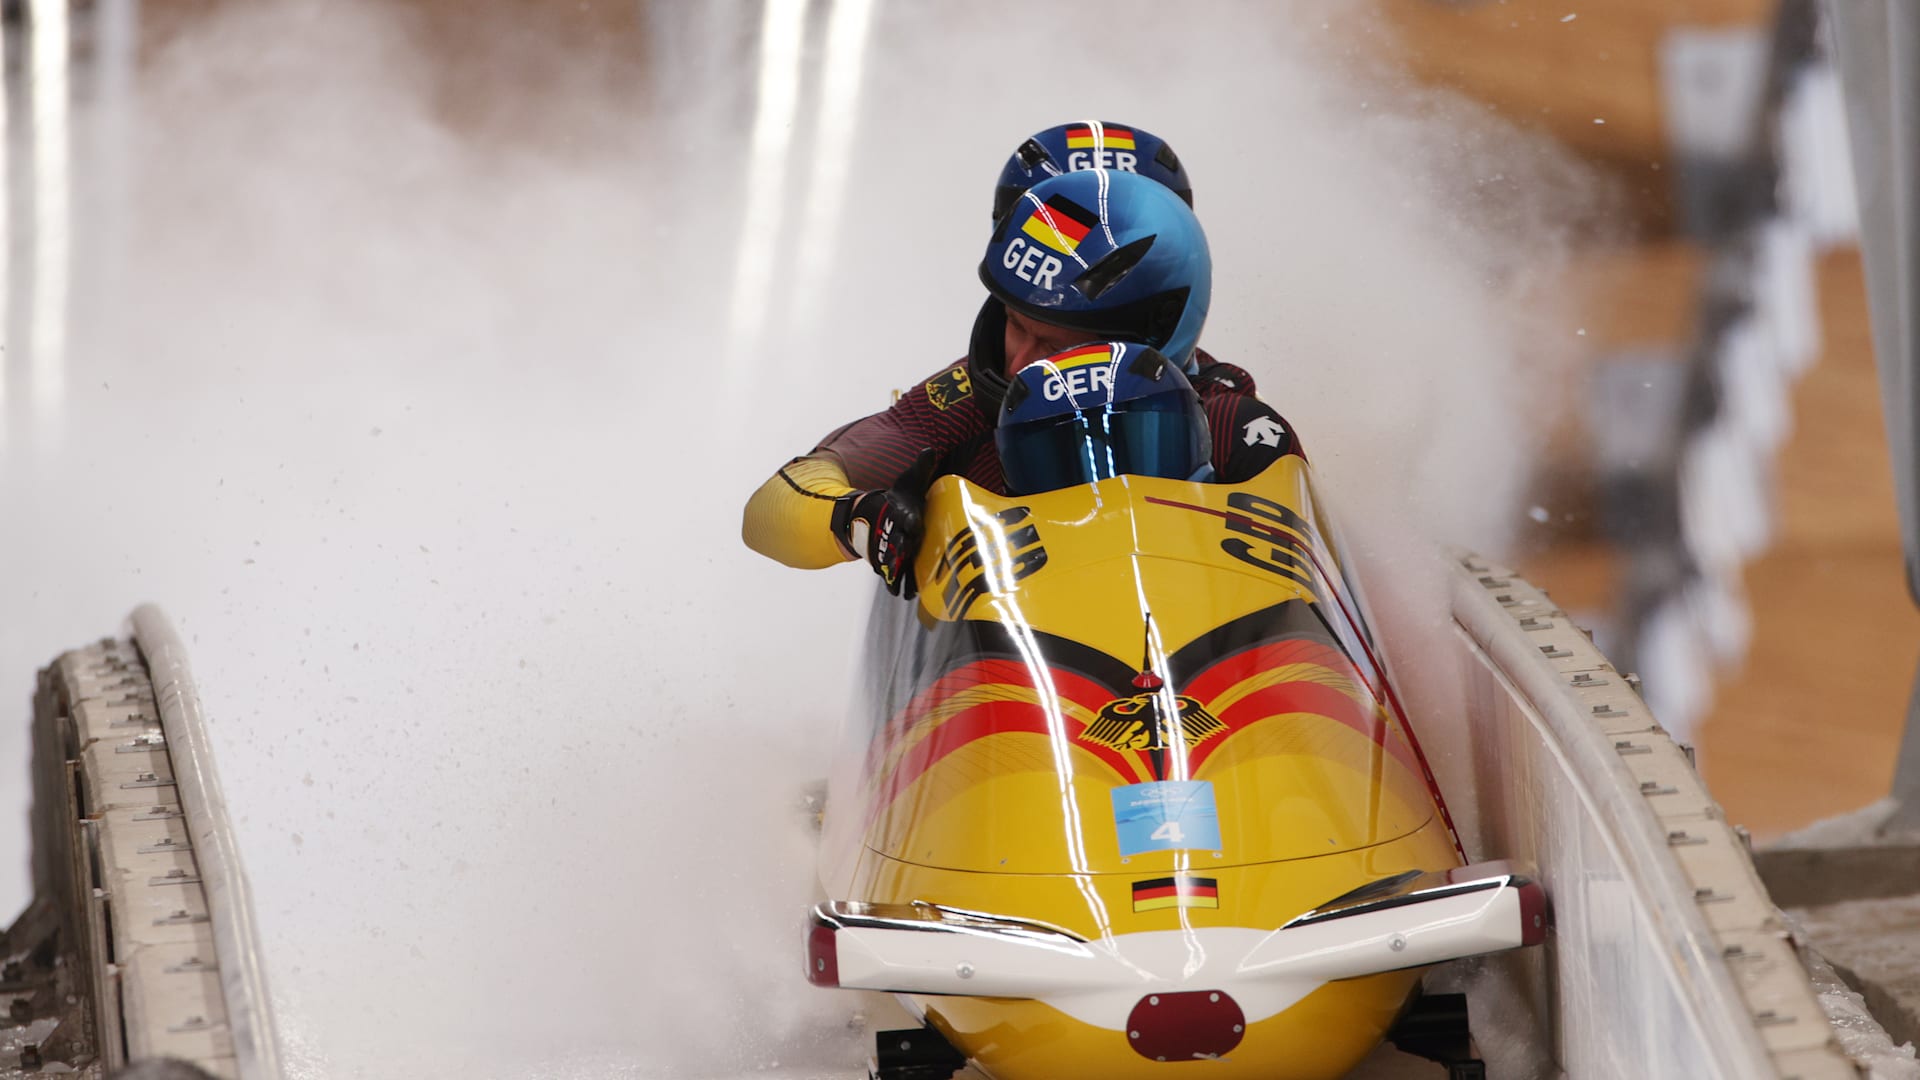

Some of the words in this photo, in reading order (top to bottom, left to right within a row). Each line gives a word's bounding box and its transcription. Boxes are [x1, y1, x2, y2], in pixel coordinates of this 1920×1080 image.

[1067, 151, 1138, 173] GER
[1003, 237, 1063, 290] GER
[1043, 365, 1112, 401] GER
[1150, 820, 1185, 843] 4
